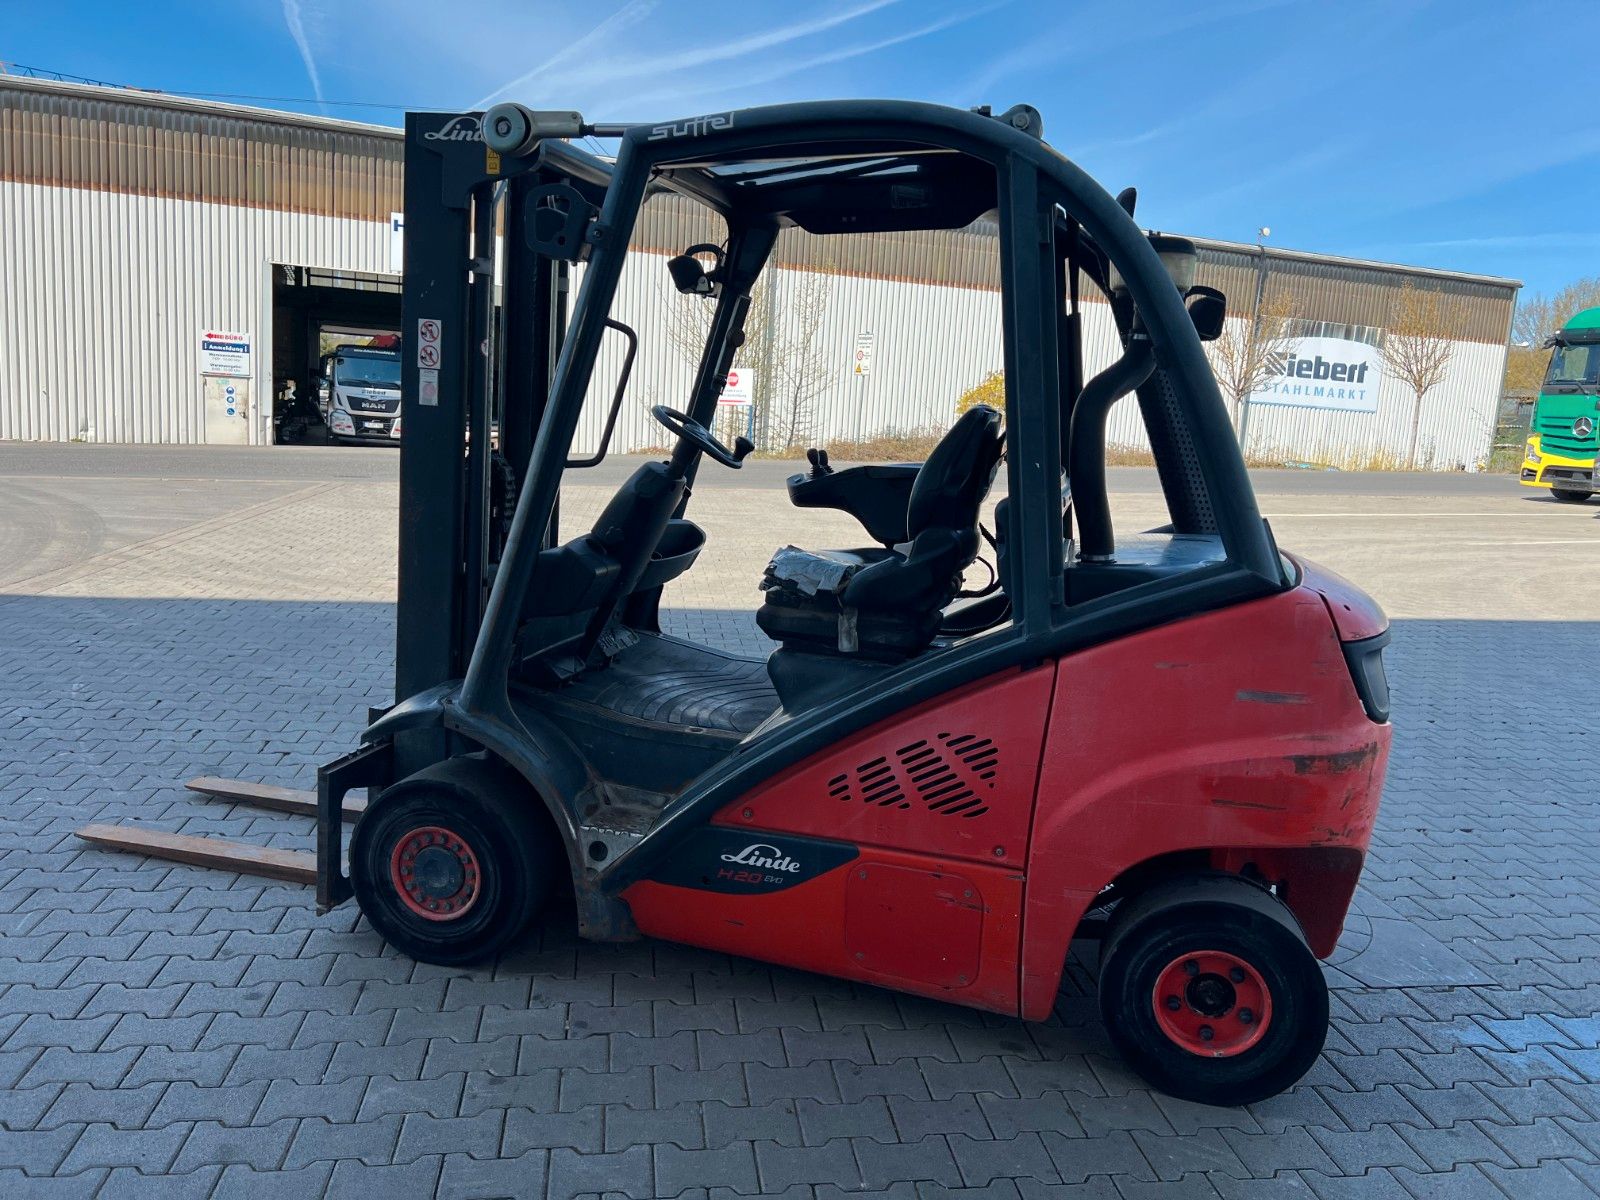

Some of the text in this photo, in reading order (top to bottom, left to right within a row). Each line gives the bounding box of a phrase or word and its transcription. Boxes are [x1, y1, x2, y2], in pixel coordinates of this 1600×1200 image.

[424, 116, 481, 141] Lin
[1263, 382, 1366, 400] STAHLMARKT
[720, 844, 801, 873] Linde
